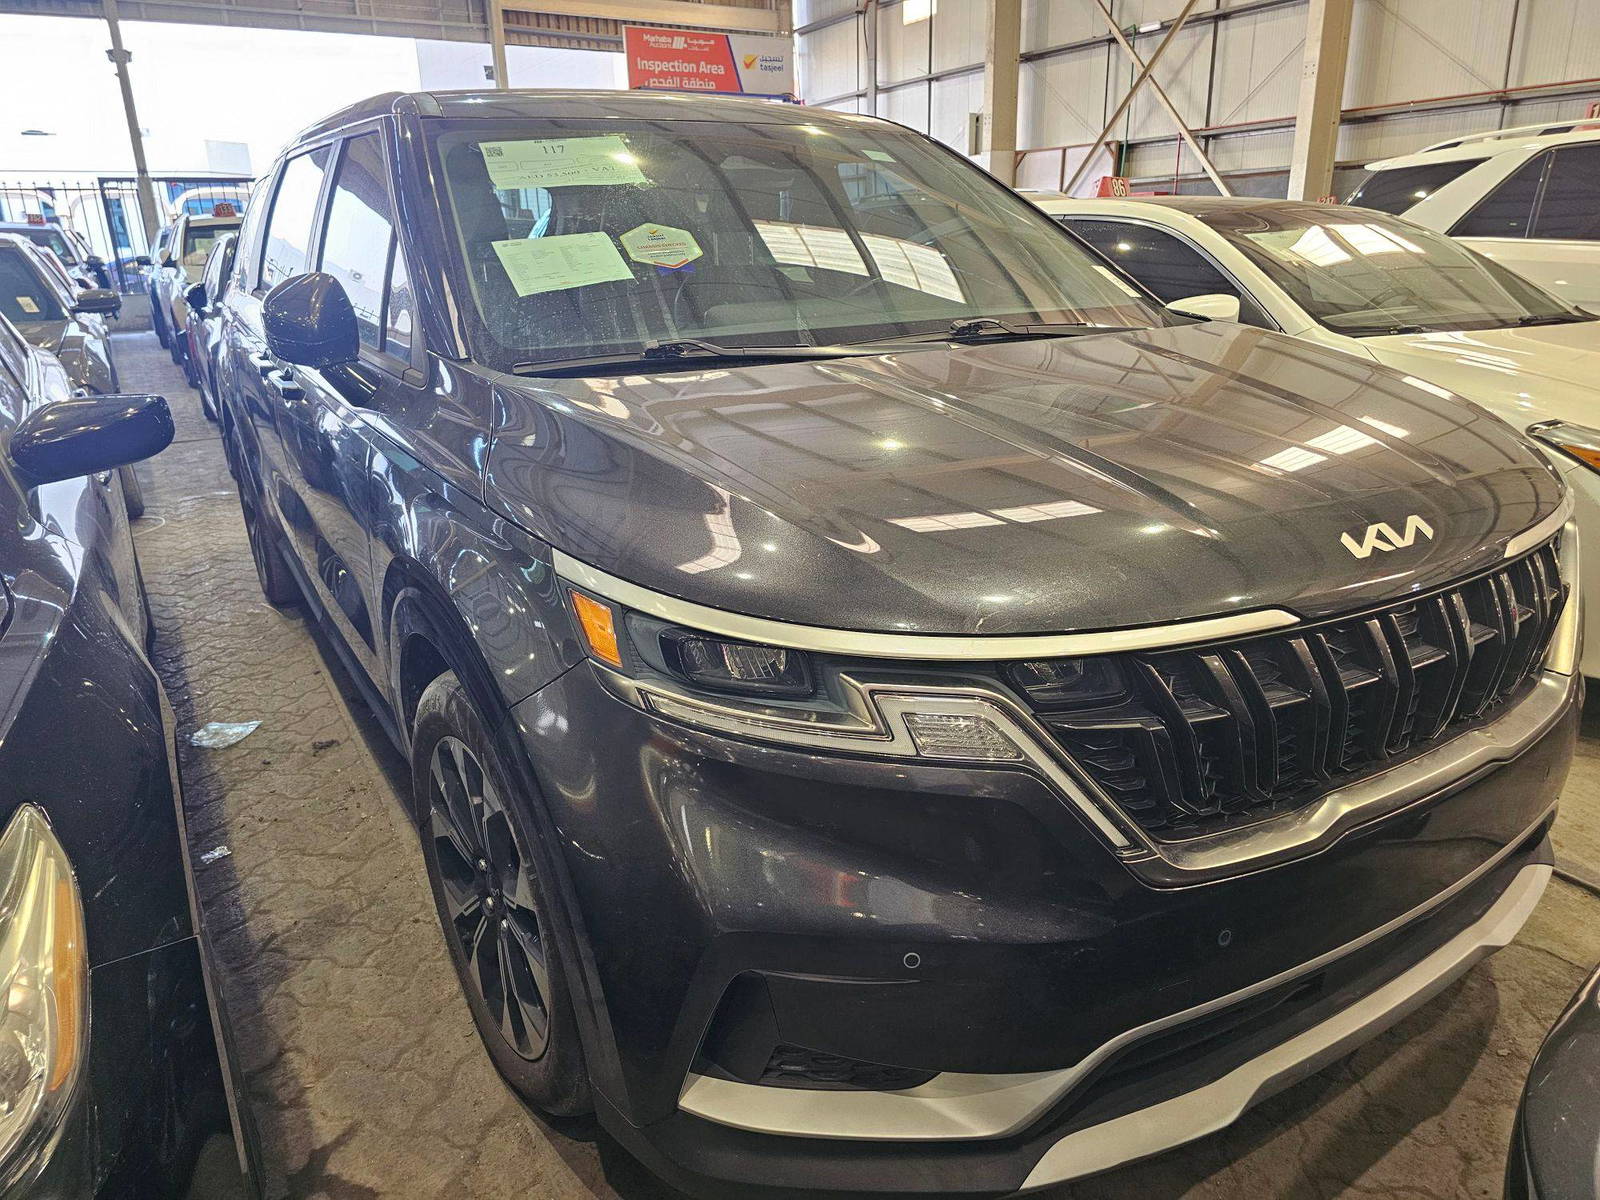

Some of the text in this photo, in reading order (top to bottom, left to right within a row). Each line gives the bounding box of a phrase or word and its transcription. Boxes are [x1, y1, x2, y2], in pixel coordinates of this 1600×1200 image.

[643, 33, 672, 43] Marhaba
[637, 56, 725, 75] Inspection Area
[760, 64, 784, 73] tasjeel
[644, 75, 717, 90] منطقة الفحص
[543, 144, 565, 154] 117
[1111, 178, 1127, 197] 86
